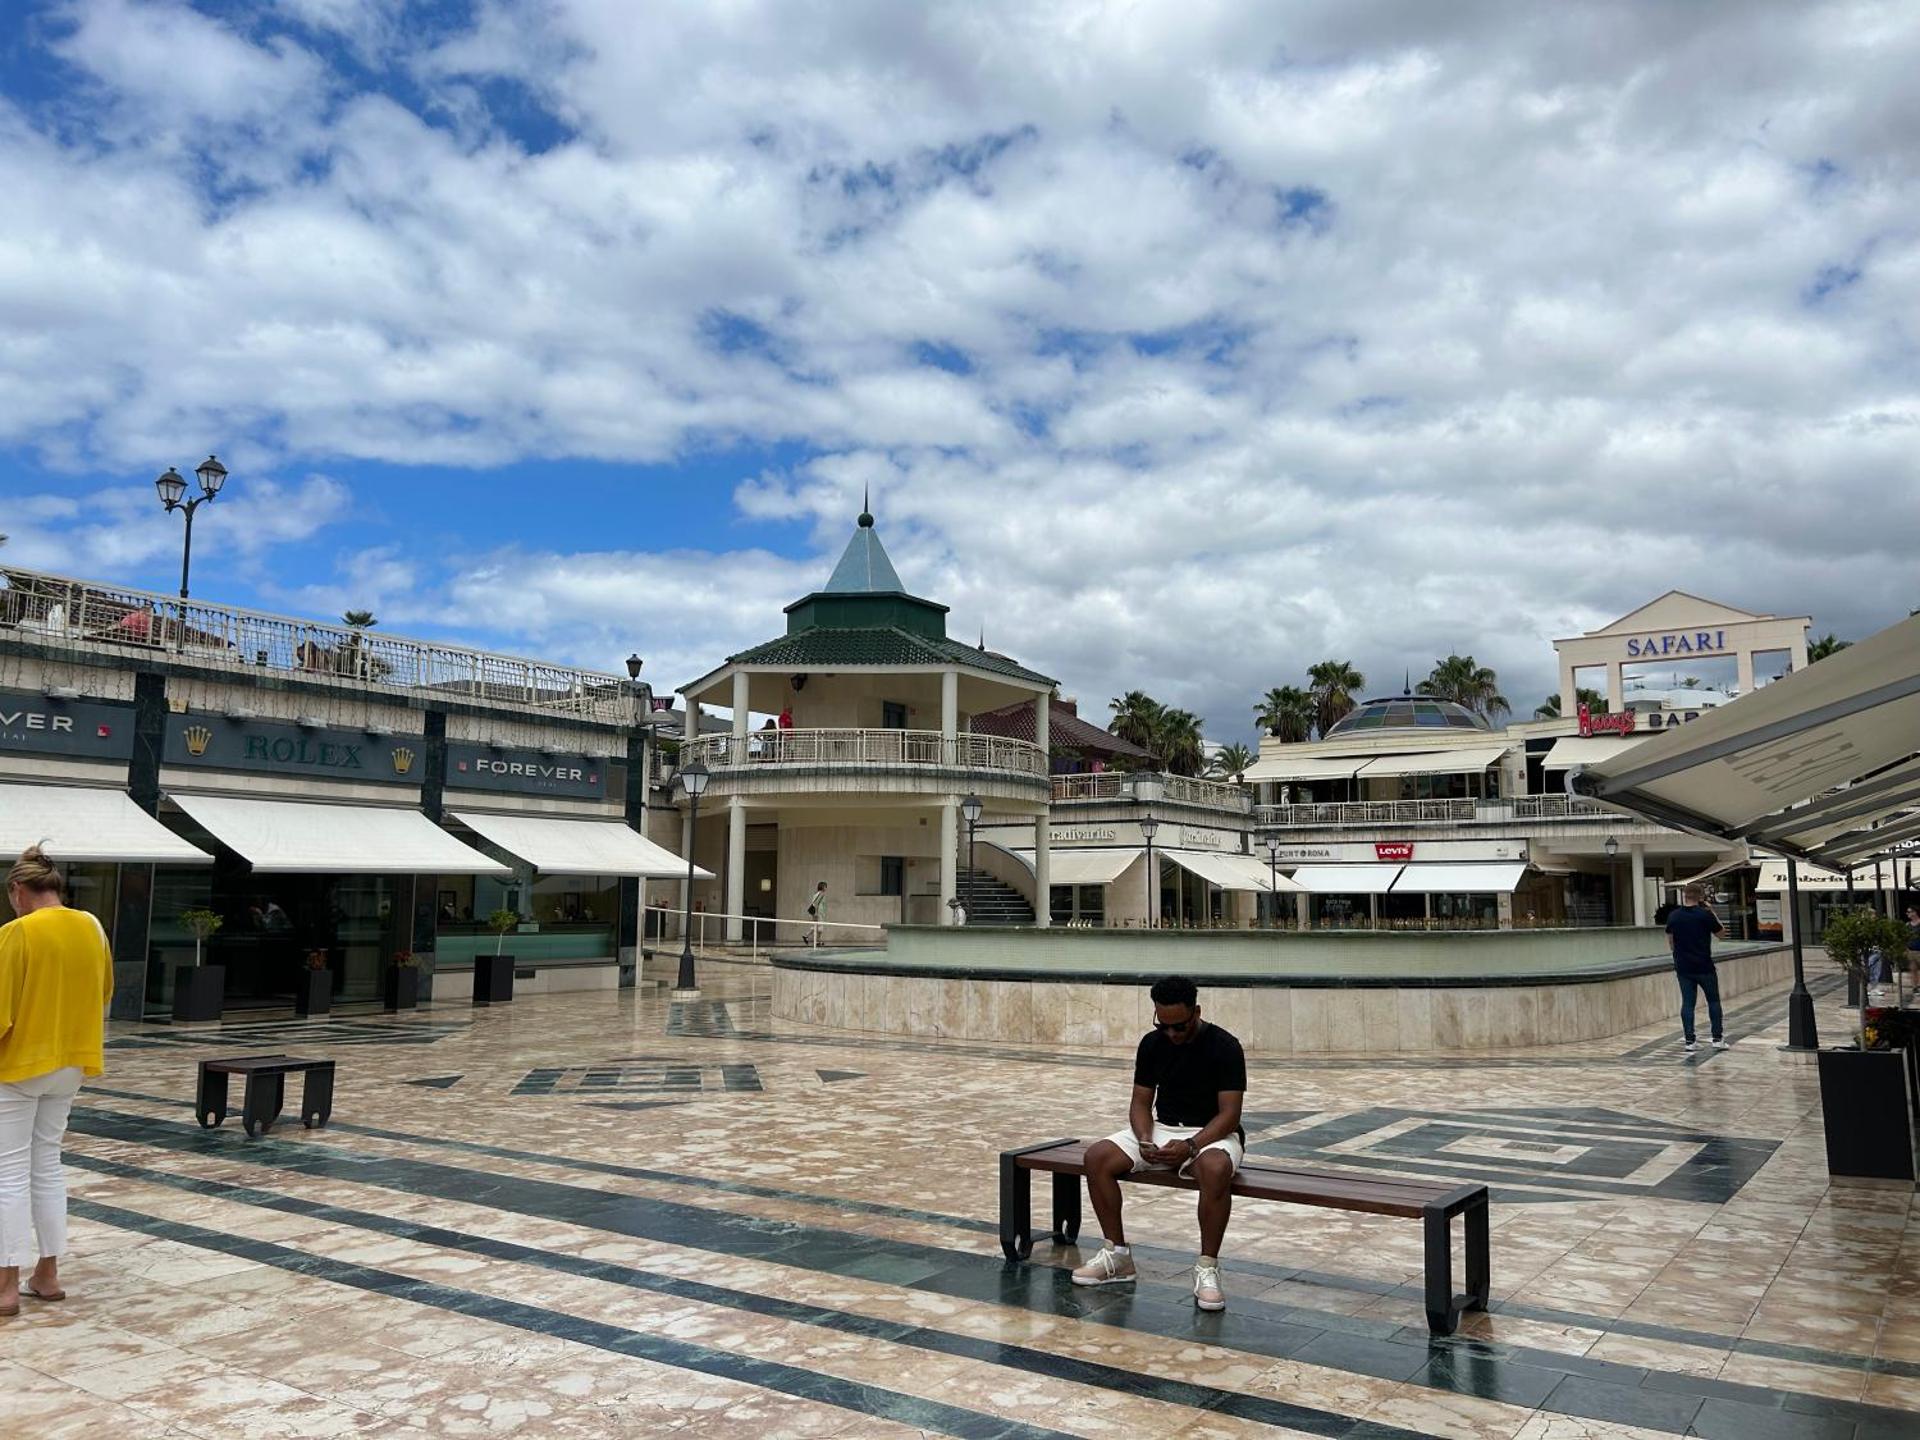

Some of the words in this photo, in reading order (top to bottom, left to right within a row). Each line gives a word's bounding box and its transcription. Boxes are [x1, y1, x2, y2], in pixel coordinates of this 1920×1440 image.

[1628, 631, 1725, 656] SAFARI
[243, 735, 363, 769] ROLEX
[476, 758, 582, 781] FOREVER
[1049, 826, 1116, 841] radivarius
[1773, 874, 1865, 883] Tiberlad
